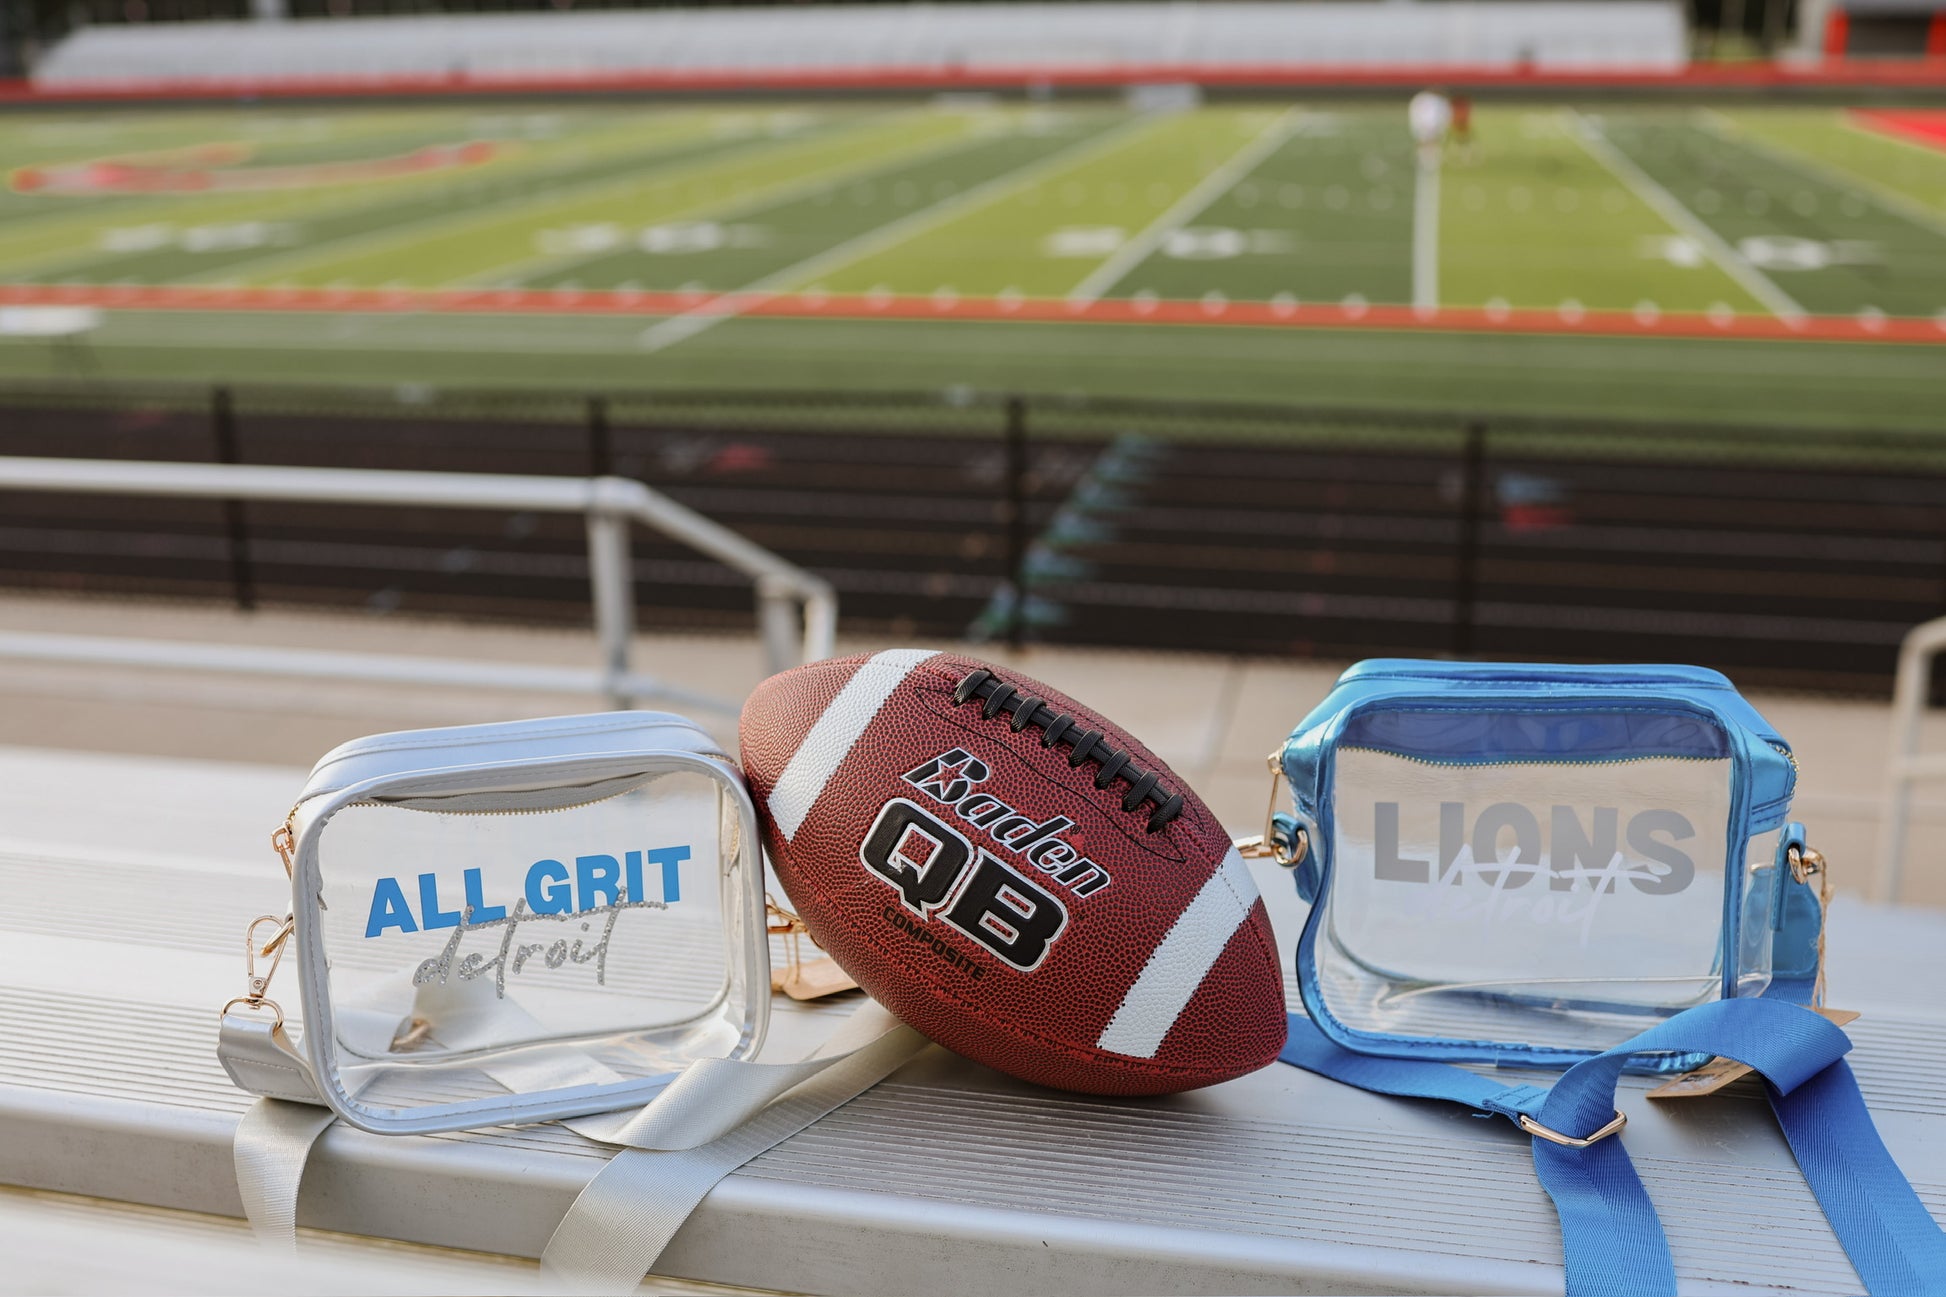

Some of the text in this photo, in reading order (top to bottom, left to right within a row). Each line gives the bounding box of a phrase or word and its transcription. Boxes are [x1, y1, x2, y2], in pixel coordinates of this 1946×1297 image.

[900, 747, 1111, 898] Baden
[1374, 801, 1695, 896] LIONS
[365, 845, 691, 938] ALL GRIT
[859, 797, 1069, 972] QB
[413, 886, 669, 1000] detroit
[882, 905, 987, 982] COMPOSITE
